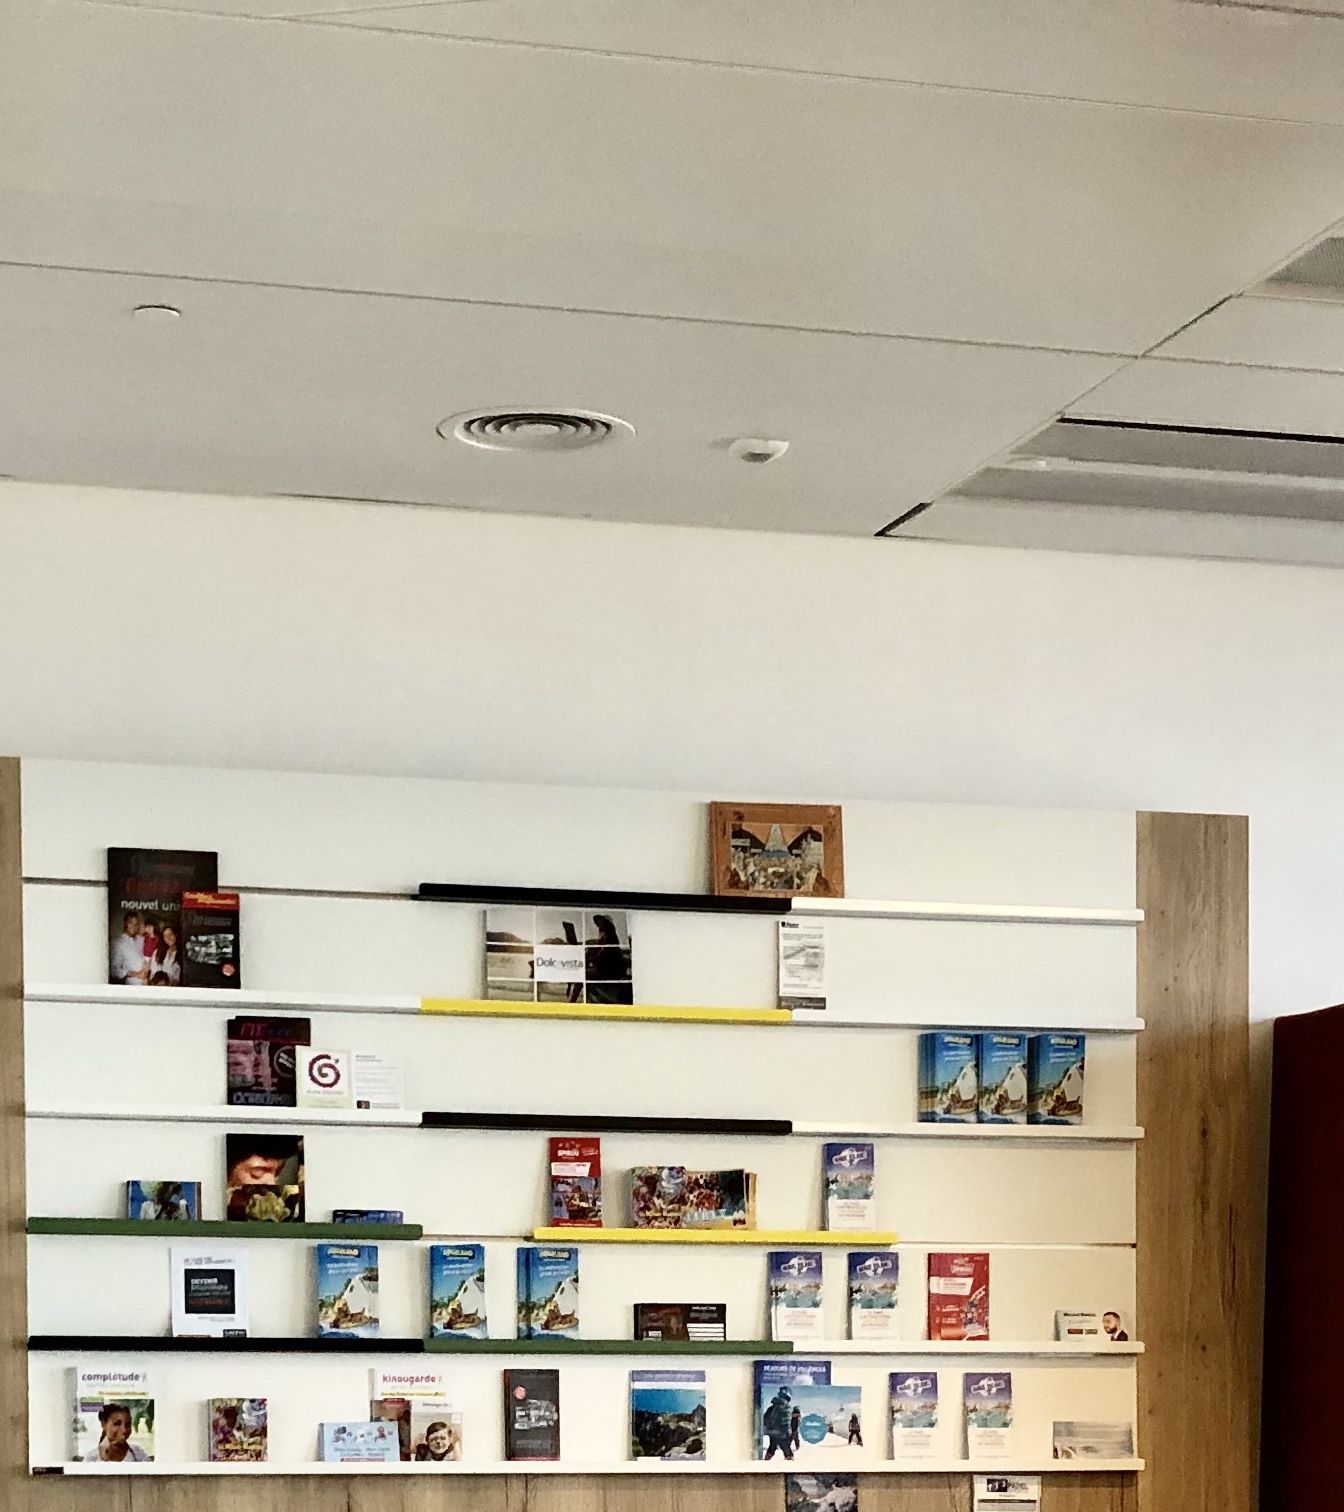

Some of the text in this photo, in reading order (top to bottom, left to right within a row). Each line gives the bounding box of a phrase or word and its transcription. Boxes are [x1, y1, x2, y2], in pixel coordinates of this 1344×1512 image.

[121, 900, 159, 910] nouvel
[81, 1371, 140, 1383] complétude
[382, 1374, 436, 1387] kinougarde
